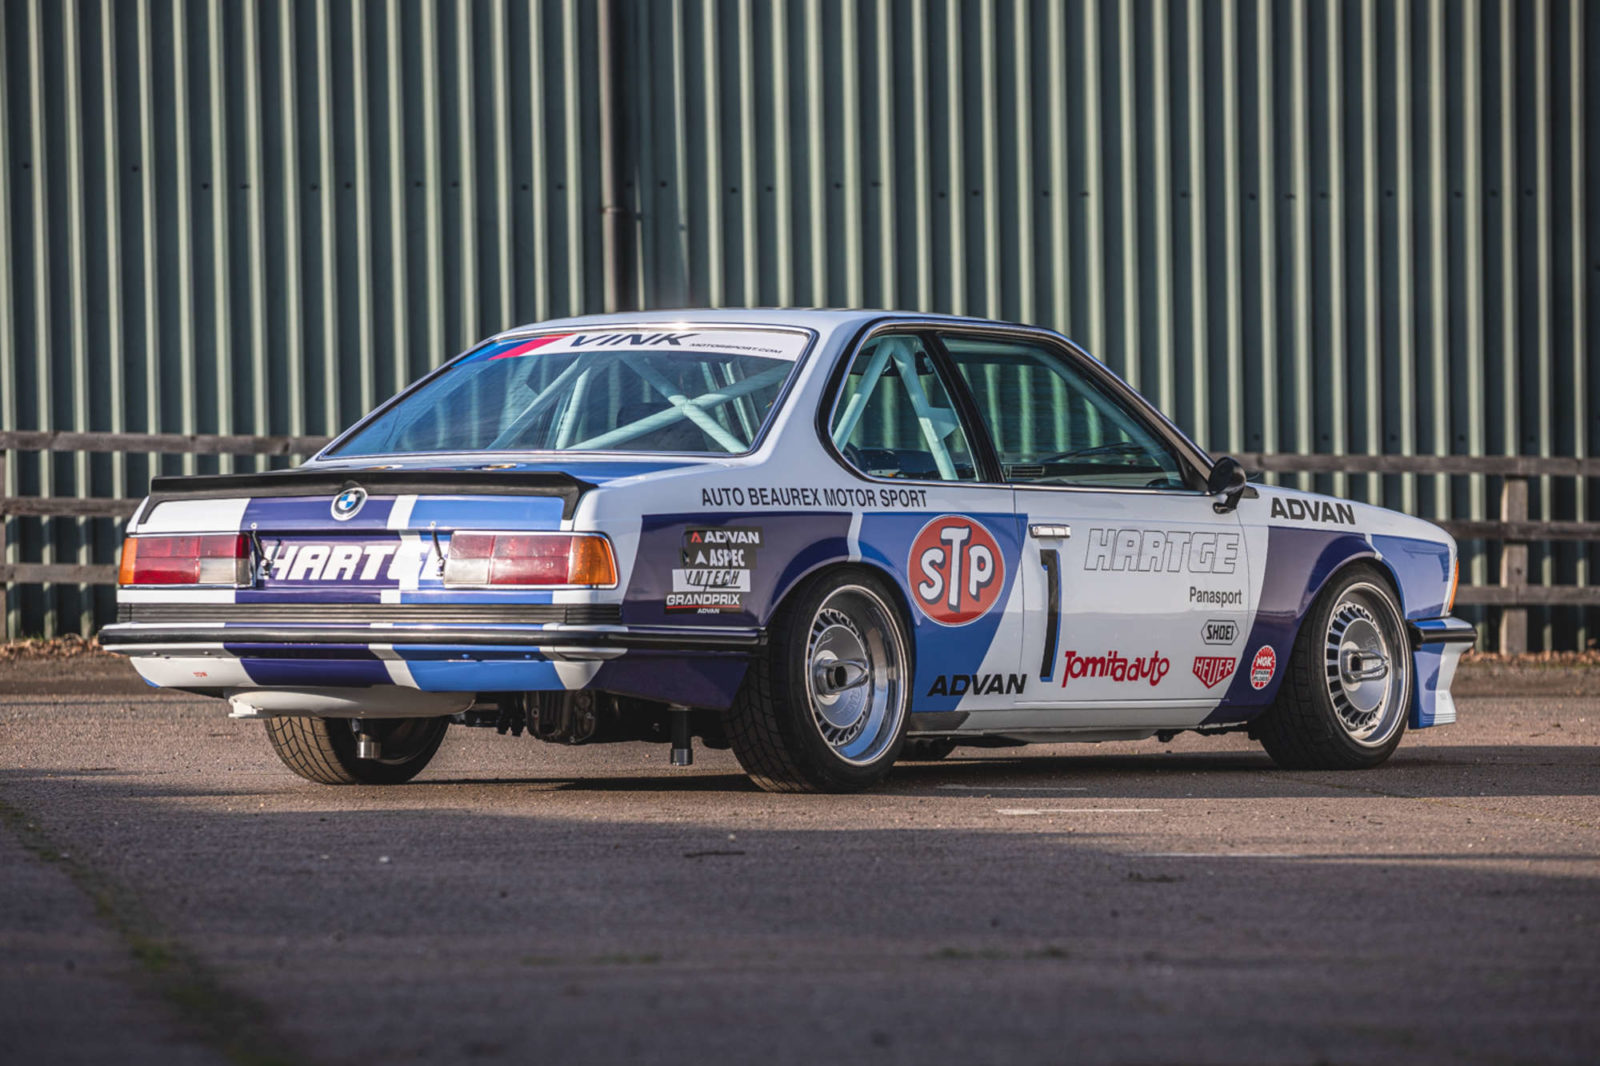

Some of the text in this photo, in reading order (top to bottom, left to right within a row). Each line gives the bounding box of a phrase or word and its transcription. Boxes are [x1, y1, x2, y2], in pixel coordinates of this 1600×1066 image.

[570, 333, 700, 347] VINK
[702, 488, 927, 508] AUTO BEAUREX MOTOR SPORT
[1271, 498, 1355, 525] ADVAN
[704, 531, 760, 544] ADVAN
[709, 549, 745, 567] ASPEC
[1084, 528, 1240, 574] HARTGE
[686, 570, 741, 585] INTECH
[918, 526, 994, 613] STP
[666, 594, 740, 606] GRANDPRIX
[1189, 586, 1242, 608] Panasport
[1206, 624, 1235, 641] SHOEI
[1256, 656, 1273, 667] NGK
[1193, 658, 1235, 686] HEUER
[927, 673, 1027, 697] ADVAN
